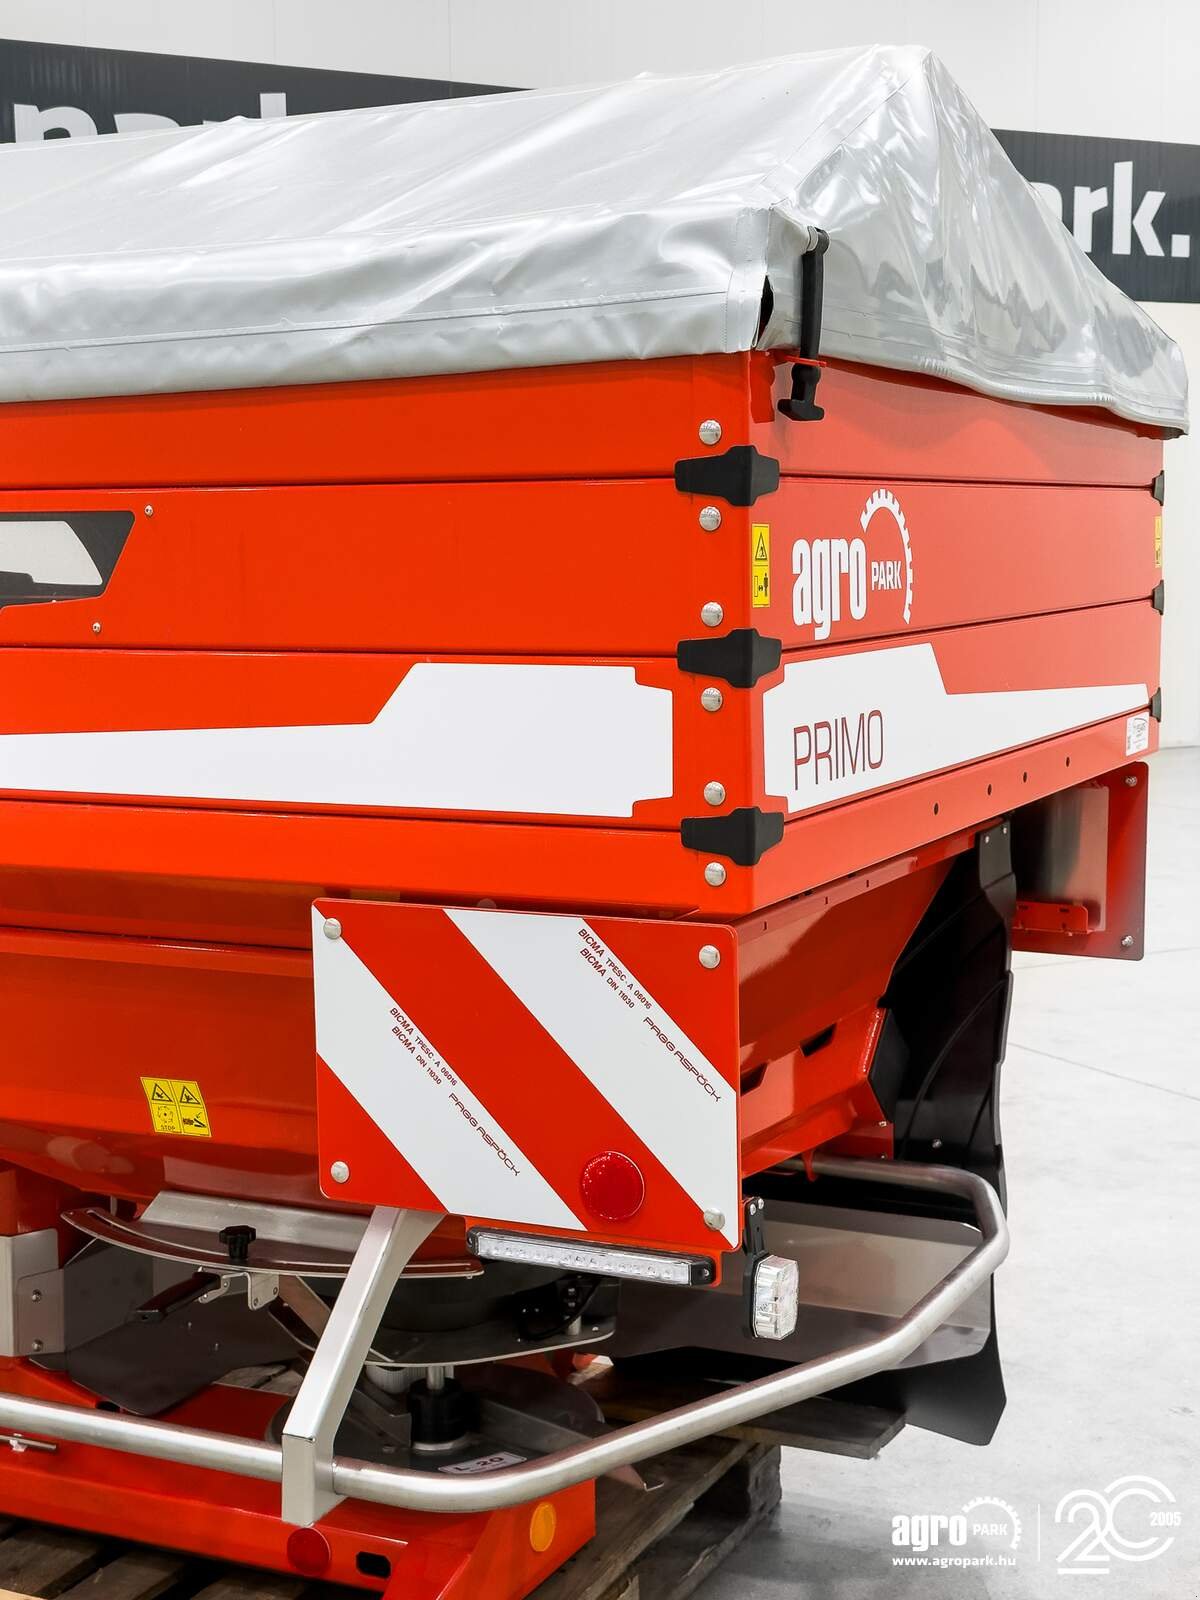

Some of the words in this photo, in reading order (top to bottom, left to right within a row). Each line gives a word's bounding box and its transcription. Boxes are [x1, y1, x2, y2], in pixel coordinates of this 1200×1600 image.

[792, 538, 867, 640] agro
[871, 561, 902, 590] PARK
[793, 709, 884, 790] PRIMO
[578, 929, 605, 957] BICMA
[580, 948, 606, 976] BICMA
[607, 977, 619, 990] DIN
[390, 1008, 414, 1035] BICMA
[392, 1026, 416, 1054] BICMA
[416, 1055, 428, 1067] DIN
